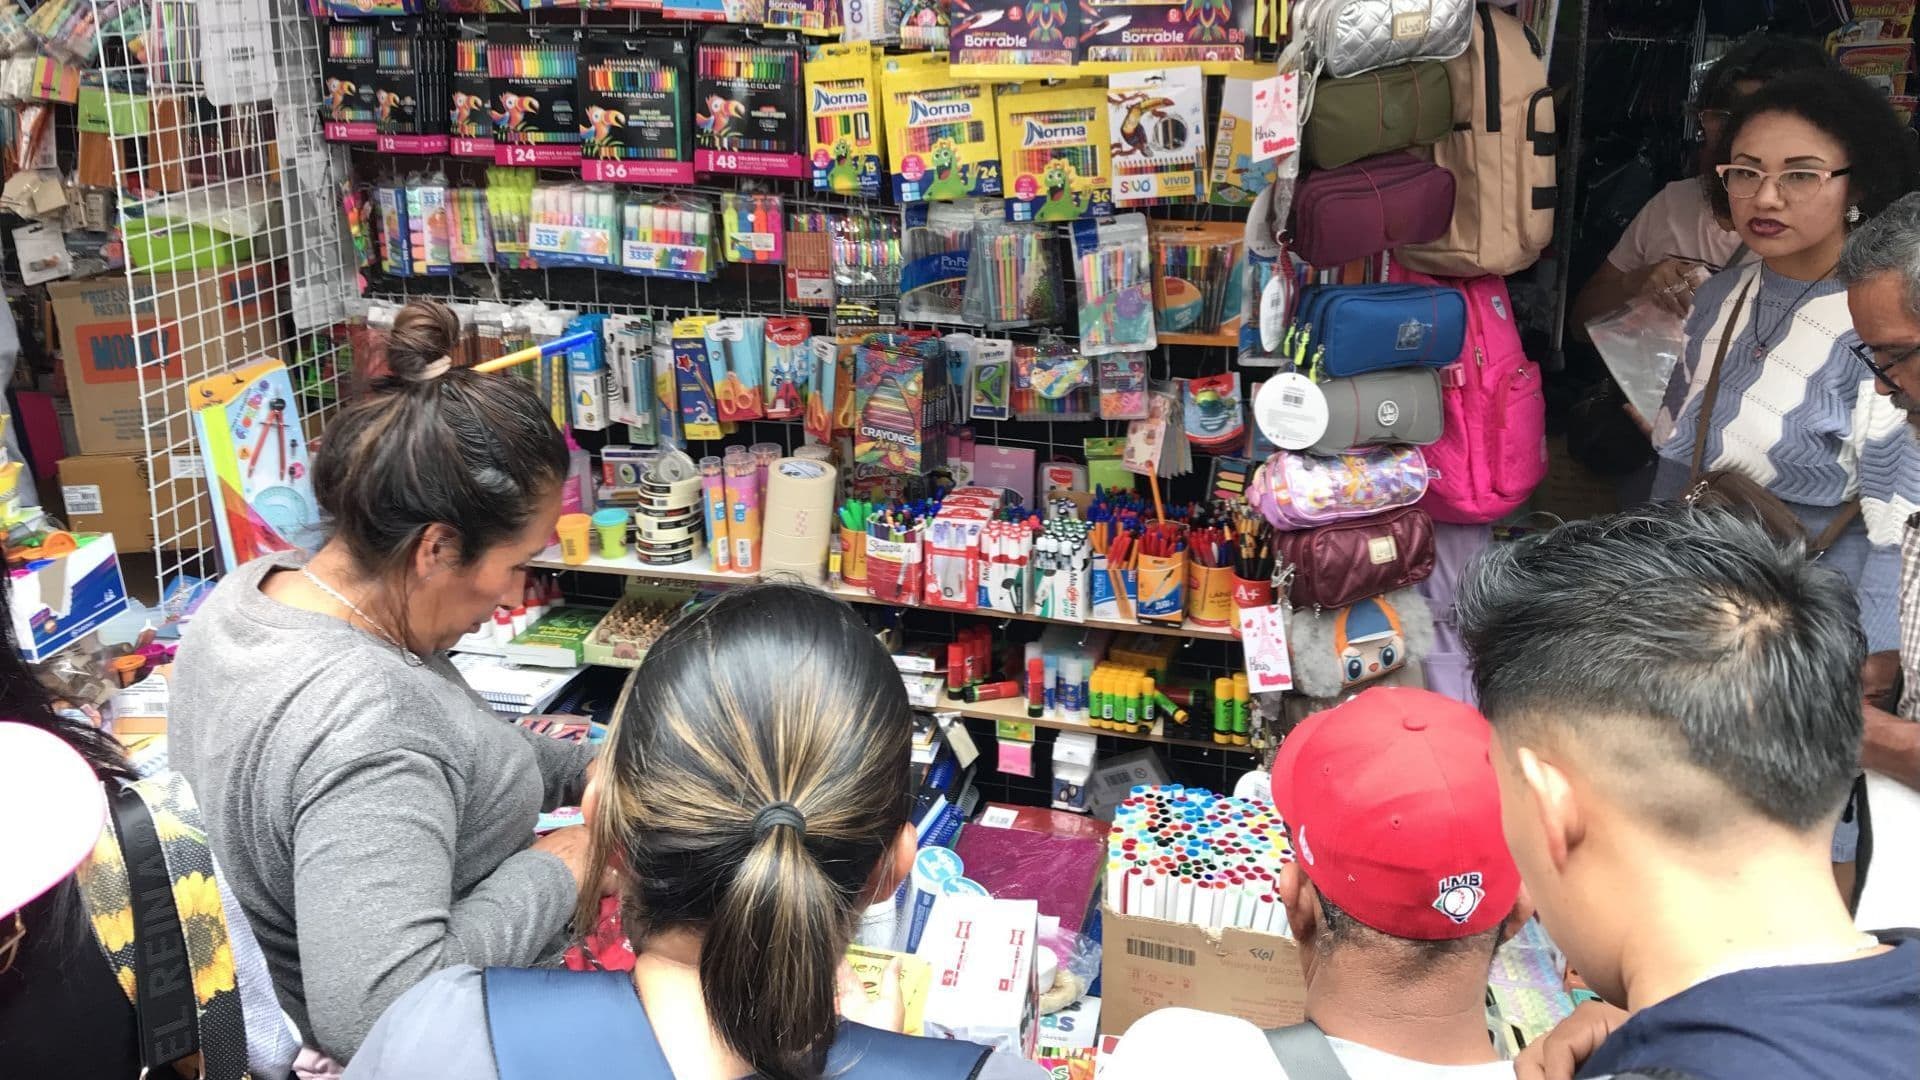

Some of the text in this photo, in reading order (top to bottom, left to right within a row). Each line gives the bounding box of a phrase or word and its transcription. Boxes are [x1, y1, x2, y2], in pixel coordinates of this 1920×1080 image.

[964, 34, 1028, 47] Borrable
[1121, 30, 1184, 43] Borrable
[327, 57, 374, 65] PRISMACOLOR
[507, 78, 573, 86] PRISMACOLOR
[716, 80, 782, 91] PRISMACOLOR
[601, 92, 667, 100] PRISMACOLOR
[813, 88, 868, 113] Norma
[909, 99, 971, 125] Norma
[335, 126, 347, 138] 12
[1024, 120, 1087, 146] Norma
[384, 138, 396, 150] 12
[460, 141, 473, 154] 12
[515, 148, 536, 162] 24
[716, 154, 737, 169] 48
[605, 163, 627, 178] 36
[980, 166, 998, 179] 24
[1163, 176, 1191, 185] VIVID
[1092, 189, 1110, 203] 36
[535, 234, 558, 247] 335
[861, 426, 915, 446] CRAYONES
[1440, 873, 1481, 893] LMB
